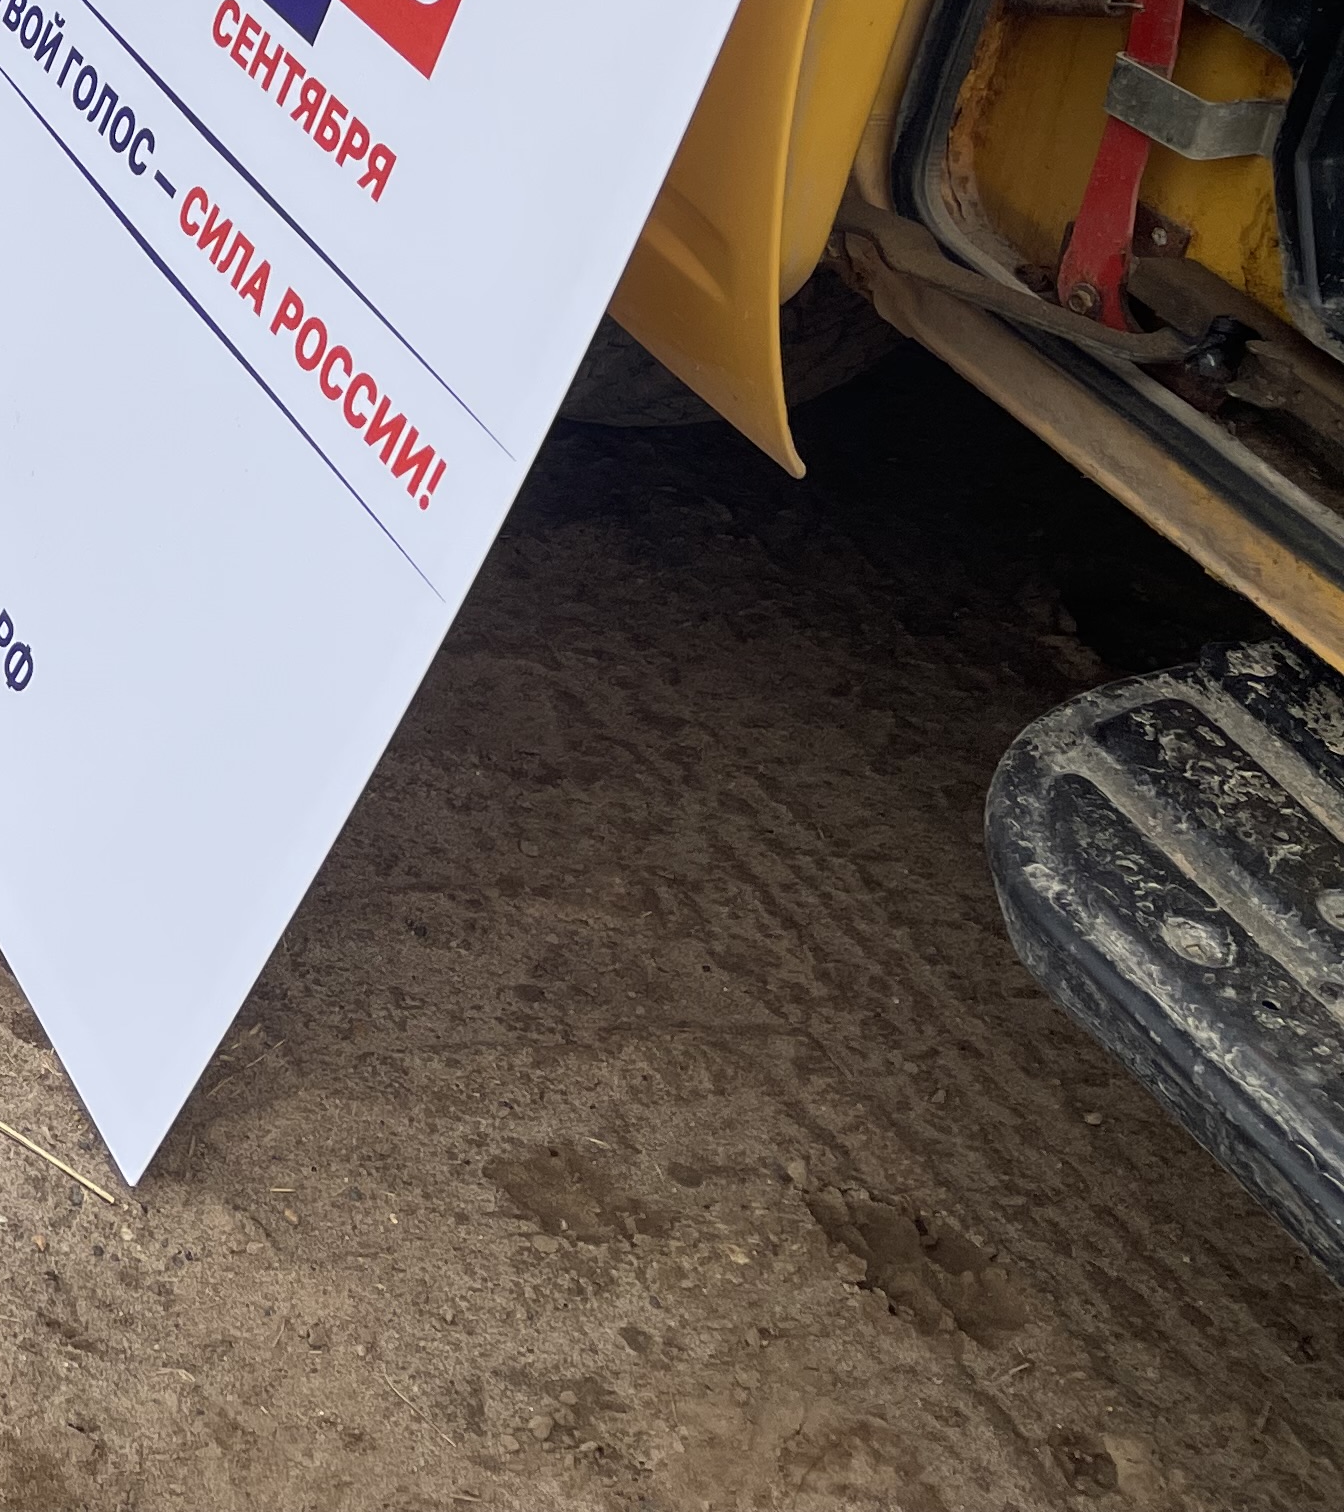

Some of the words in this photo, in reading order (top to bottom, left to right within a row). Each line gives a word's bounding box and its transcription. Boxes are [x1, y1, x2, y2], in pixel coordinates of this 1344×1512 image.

[213, 0, 396, 201] СЕНТЯБРЯ
[57, 46, 155, 175] ГОЛОС
[180, 187, 270, 316] СИЛА
[271, 288, 446, 510] РОССИИ!
